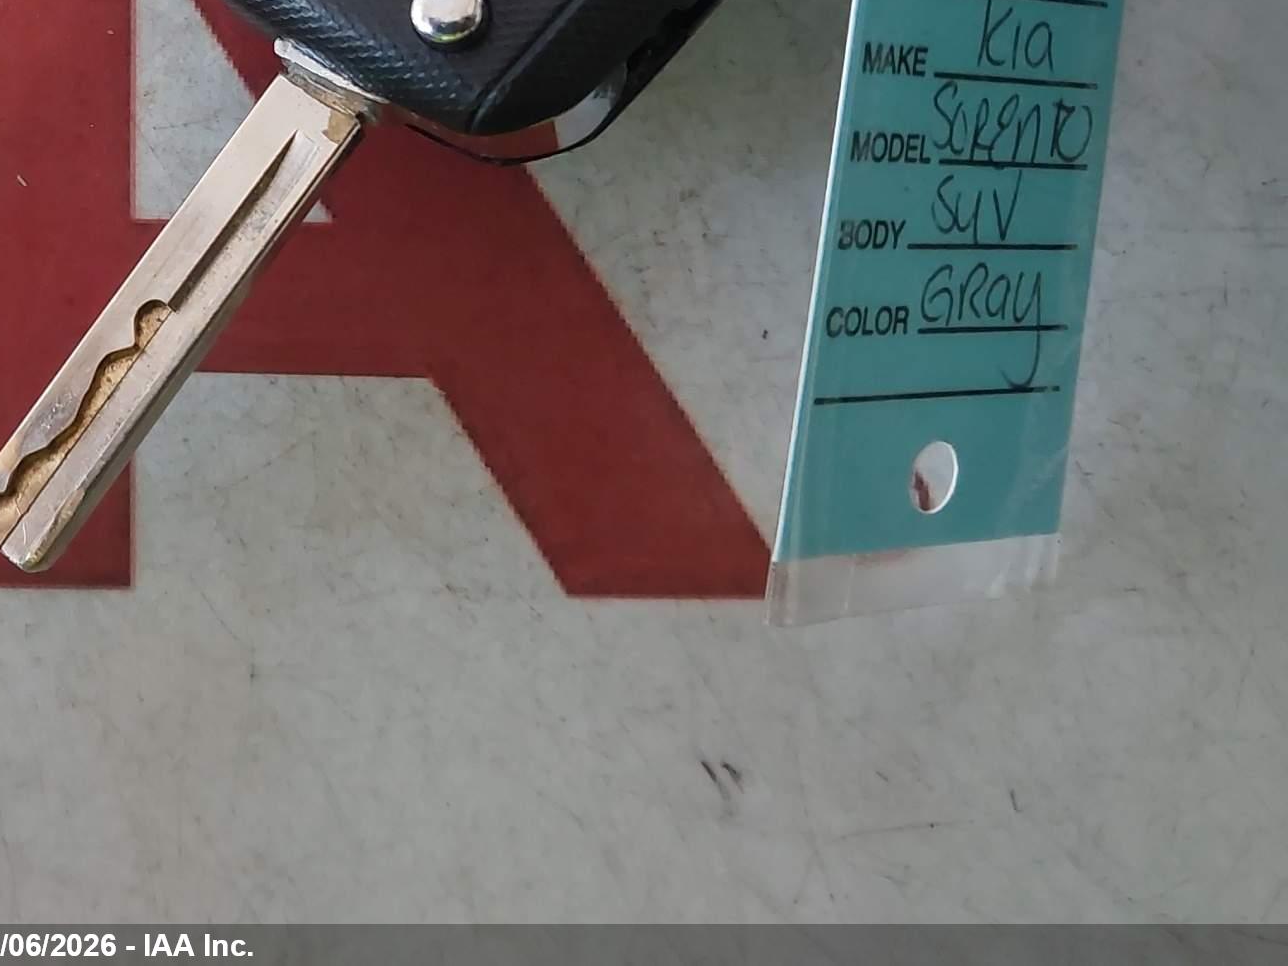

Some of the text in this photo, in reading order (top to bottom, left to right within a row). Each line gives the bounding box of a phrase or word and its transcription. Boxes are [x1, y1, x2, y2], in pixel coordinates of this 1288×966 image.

[862, 42, 929, 77] MAKE
[850, 131, 931, 164] MODEL
[838, 219, 906, 250] BODY
[825, 306, 910, 338] COLOR
